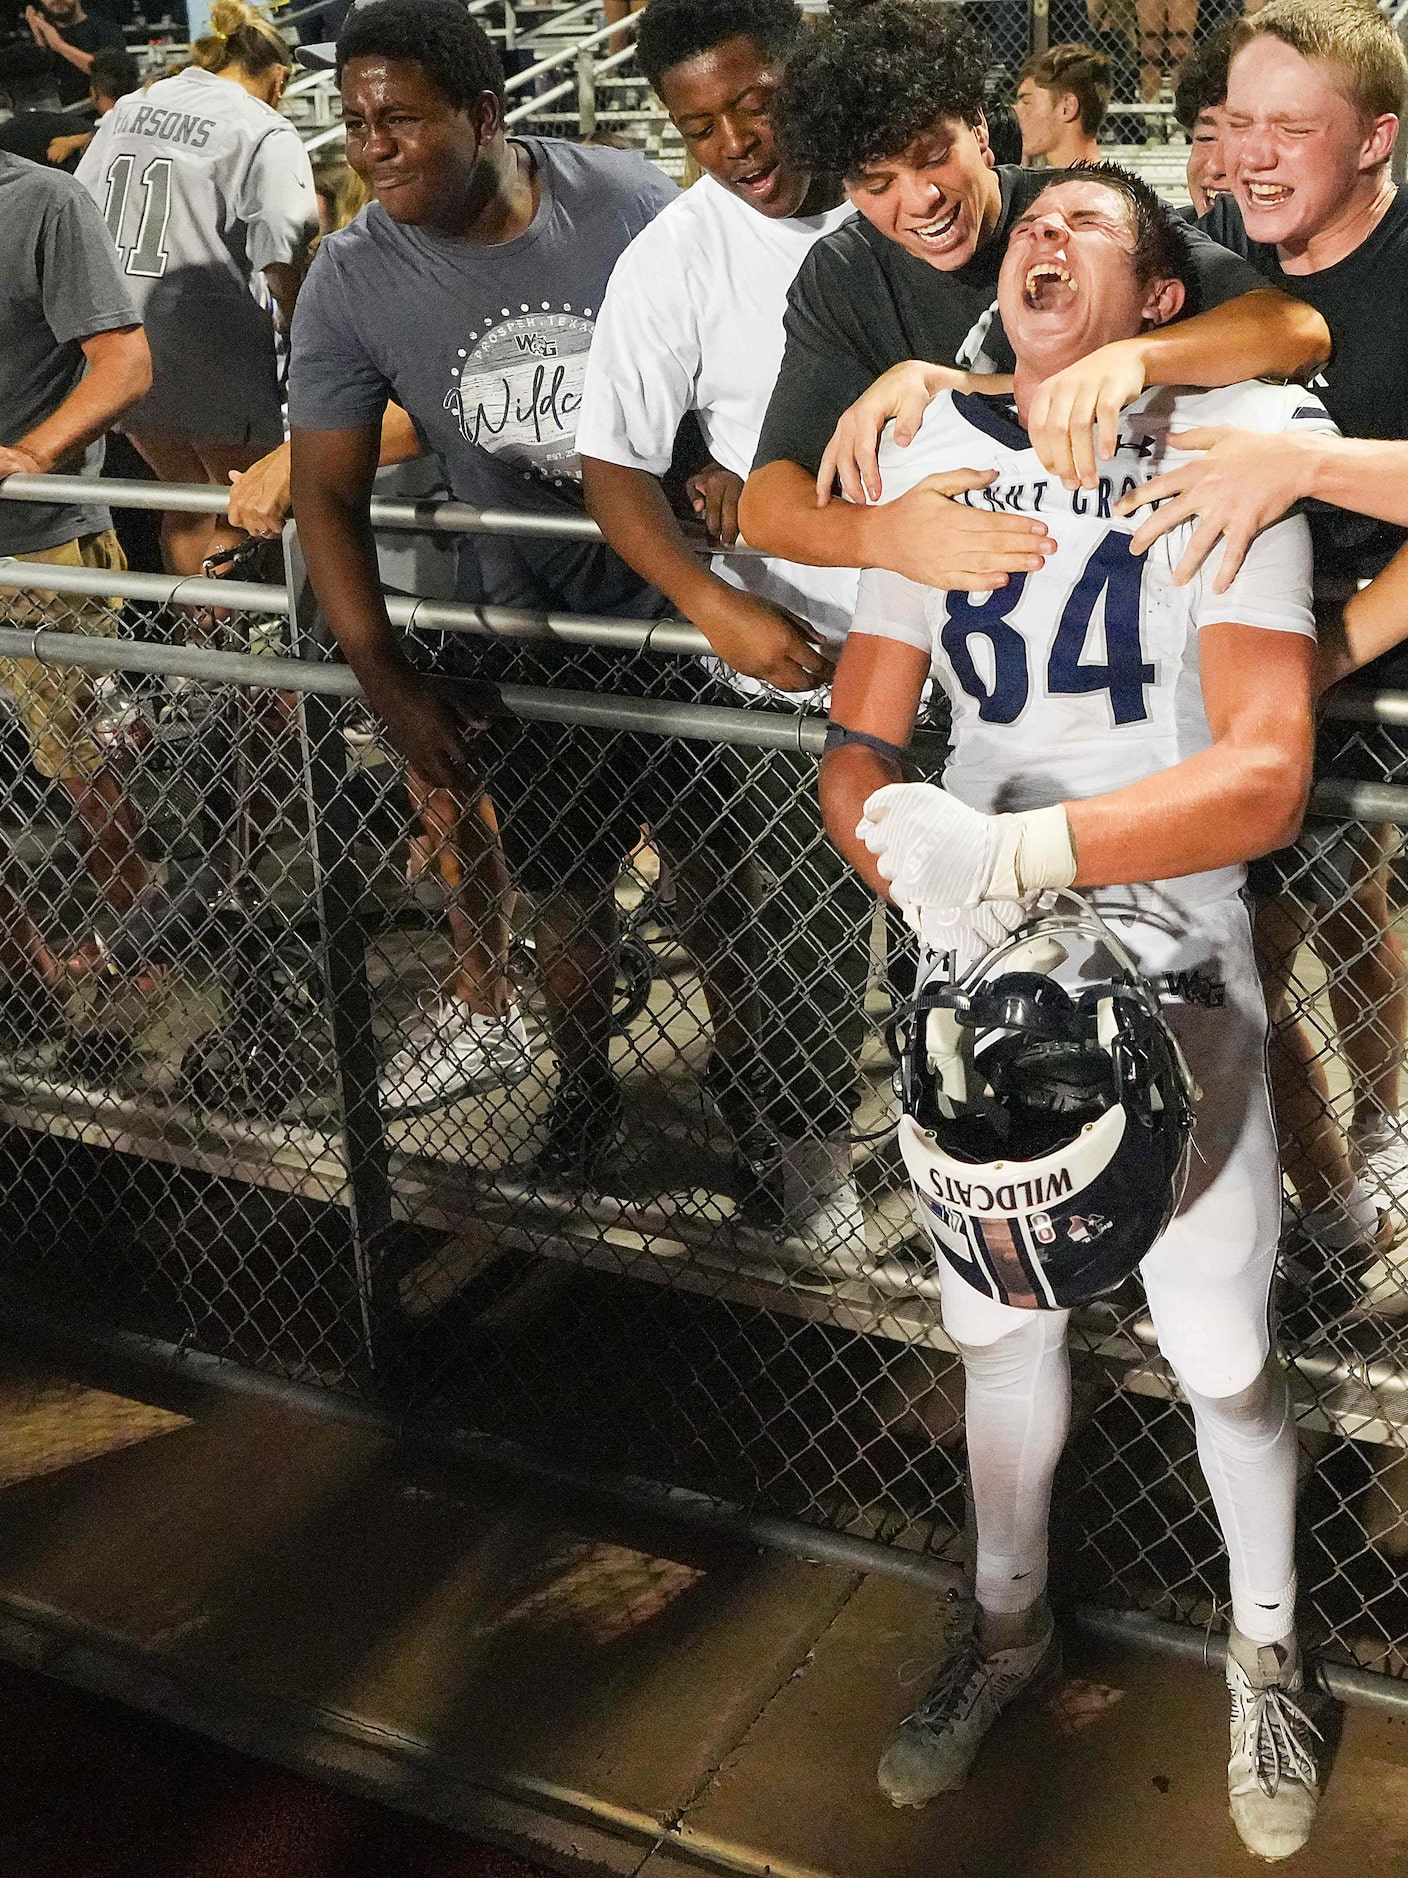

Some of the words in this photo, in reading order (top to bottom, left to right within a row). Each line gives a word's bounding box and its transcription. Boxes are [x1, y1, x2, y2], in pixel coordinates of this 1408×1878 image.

[105, 154, 173, 277] 11
[941, 529, 1160, 730] 84
[929, 1167, 1073, 1211] WILDCATS
